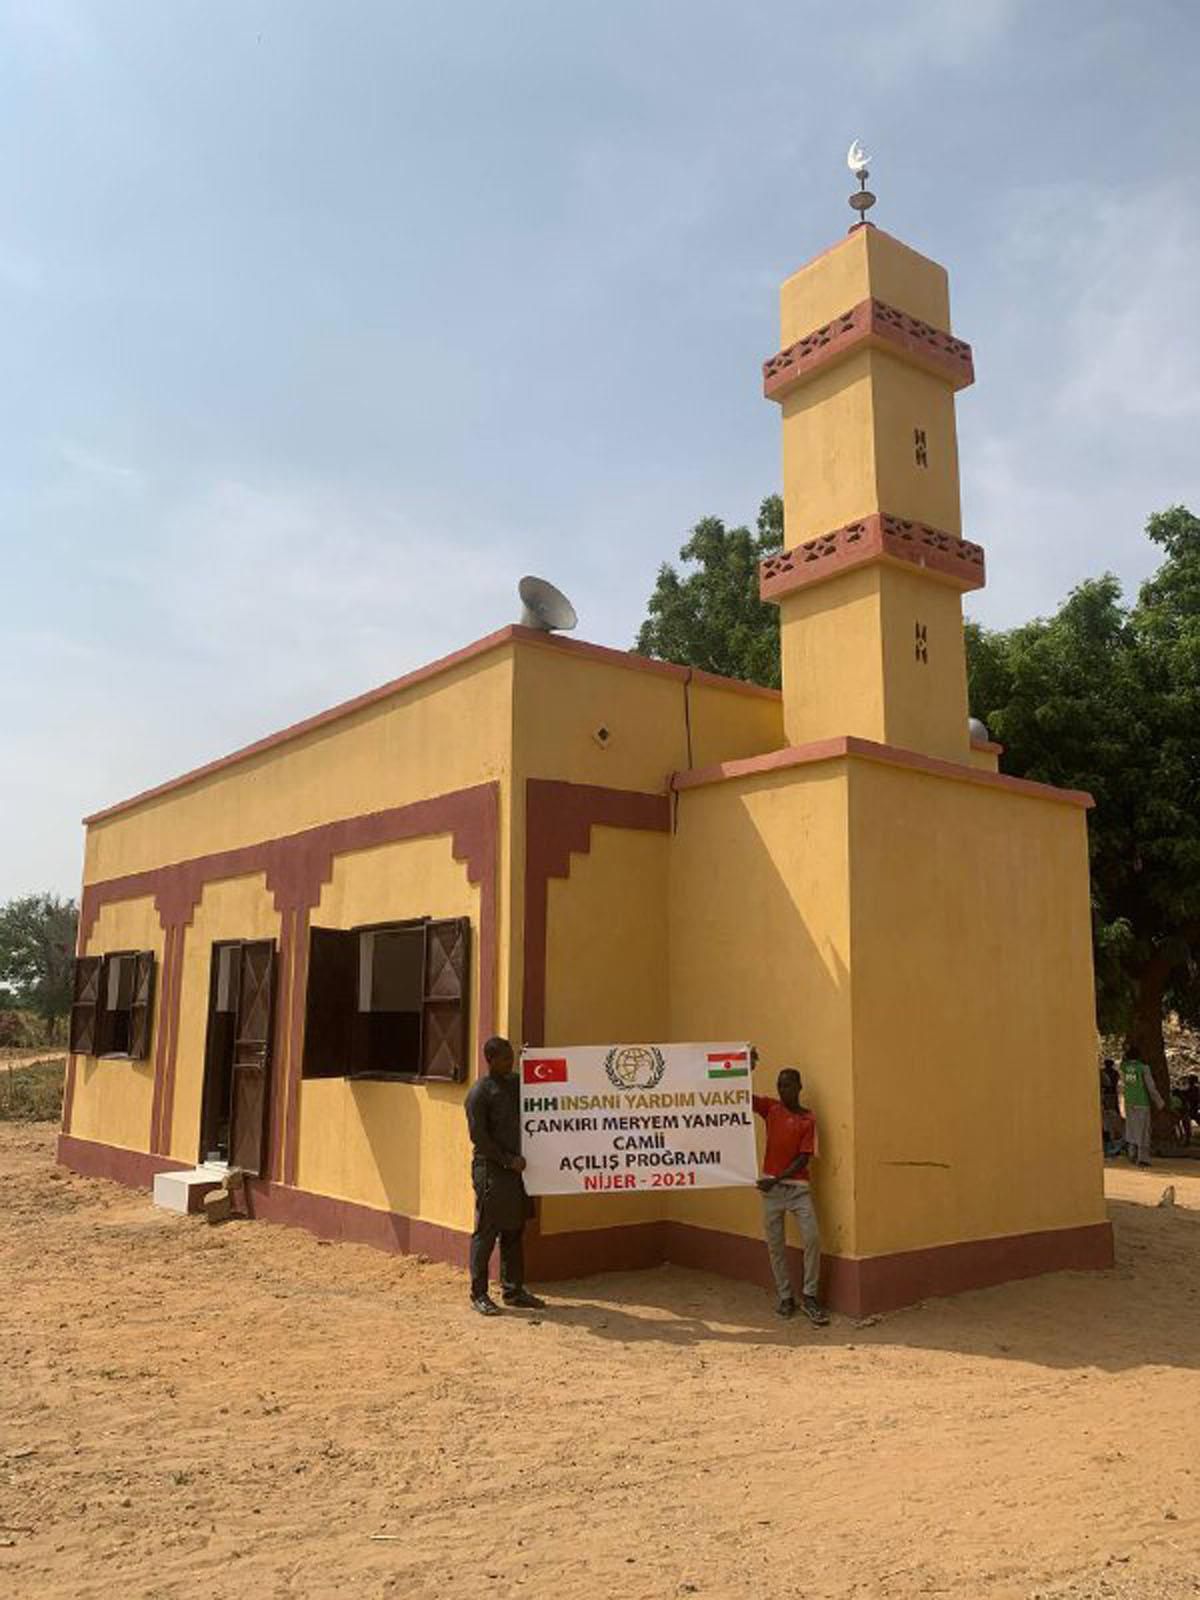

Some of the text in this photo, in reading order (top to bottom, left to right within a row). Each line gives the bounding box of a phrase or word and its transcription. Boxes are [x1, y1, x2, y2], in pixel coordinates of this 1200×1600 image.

[624, 1092, 695, 1109] YARDIM
[698, 1089, 750, 1106] VAKFI
[524, 1112, 752, 1137] ÇANKIRI MERYEM YANPAL
[559, 1150, 721, 1173] AÇILIŞ PROĞRAMI
[584, 1172, 636, 1190] NİJER
[651, 1171, 696, 1187] 2021
